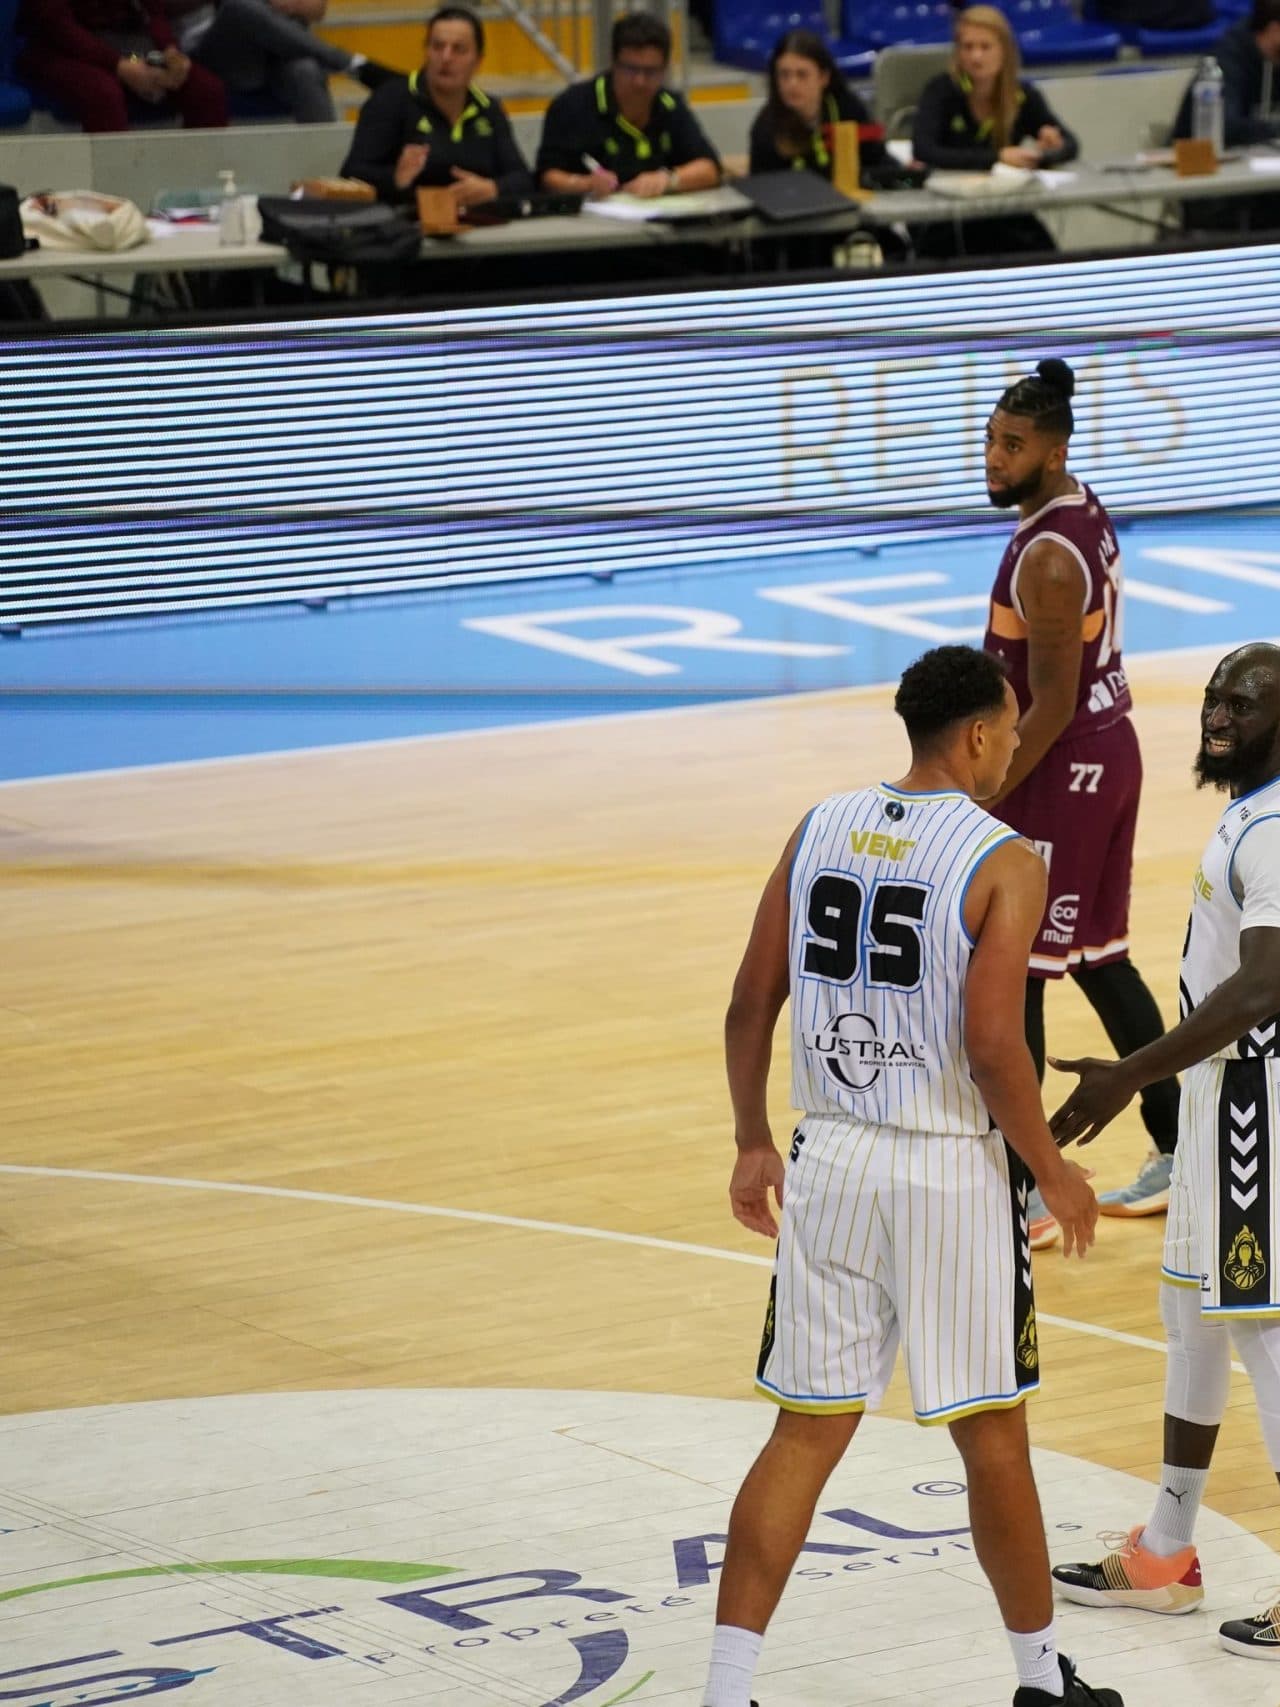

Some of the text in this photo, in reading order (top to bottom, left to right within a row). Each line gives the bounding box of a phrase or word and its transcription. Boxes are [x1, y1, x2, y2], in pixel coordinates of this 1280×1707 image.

[1069, 762, 1103, 793] 77
[802, 874, 929, 989] 95
[796, 1522, 1083, 1581] Servis
